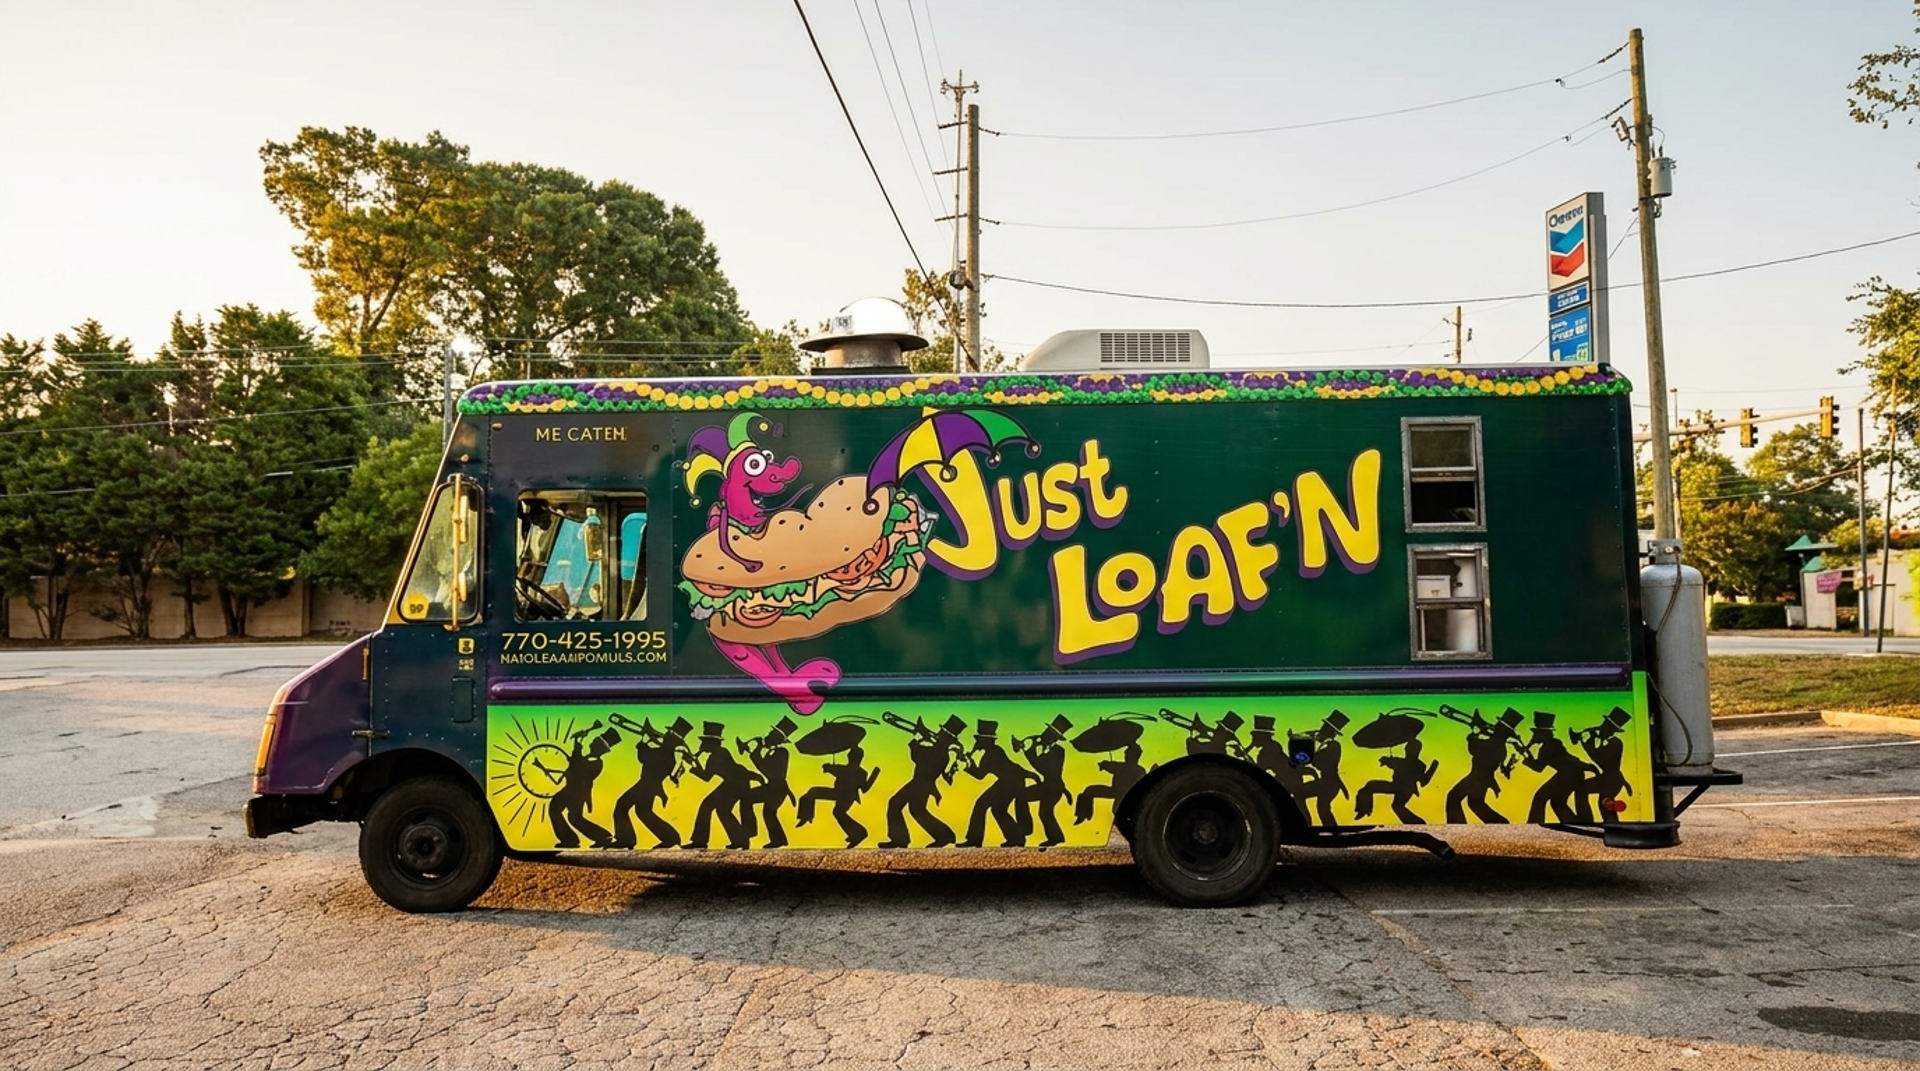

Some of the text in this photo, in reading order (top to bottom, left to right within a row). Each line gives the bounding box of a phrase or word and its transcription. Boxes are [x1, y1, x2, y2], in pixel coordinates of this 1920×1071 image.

[536, 427, 562, 442] ME
[918, 439, 1128, 579] Just
[501, 631, 667, 650] 770-425-1995
